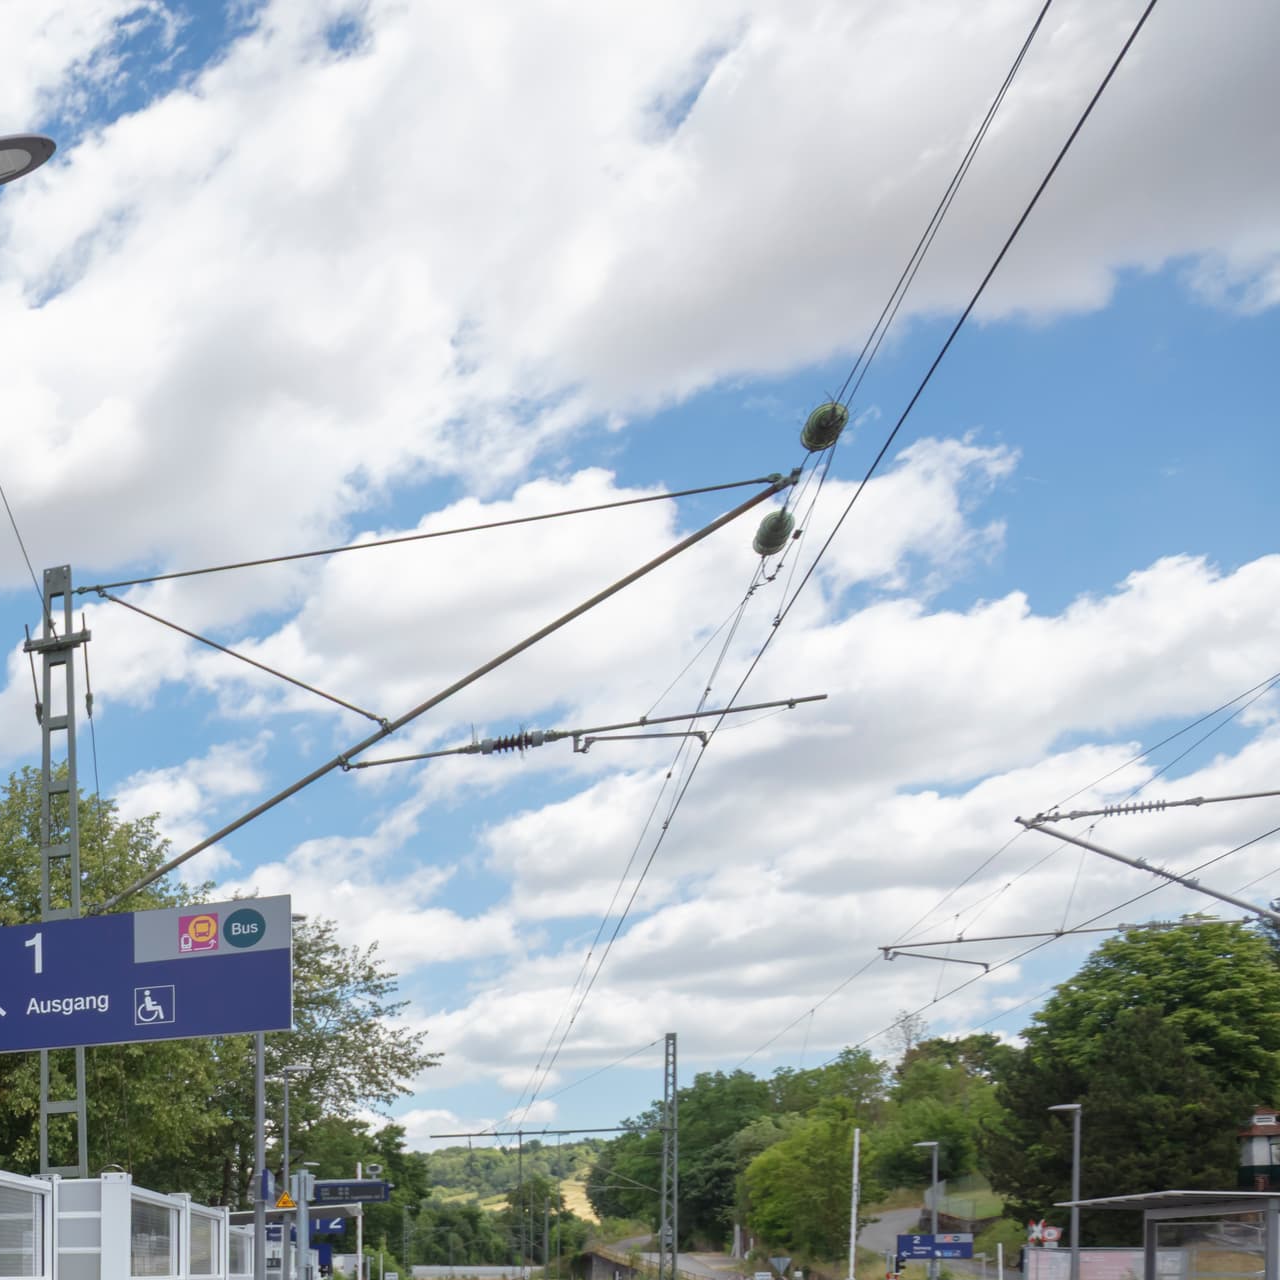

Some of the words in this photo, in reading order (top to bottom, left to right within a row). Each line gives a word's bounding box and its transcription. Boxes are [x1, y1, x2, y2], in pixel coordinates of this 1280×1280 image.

[231, 922, 258, 936] Bus
[24, 932, 43, 974] 1
[26, 994, 109, 1016] Ausgang
